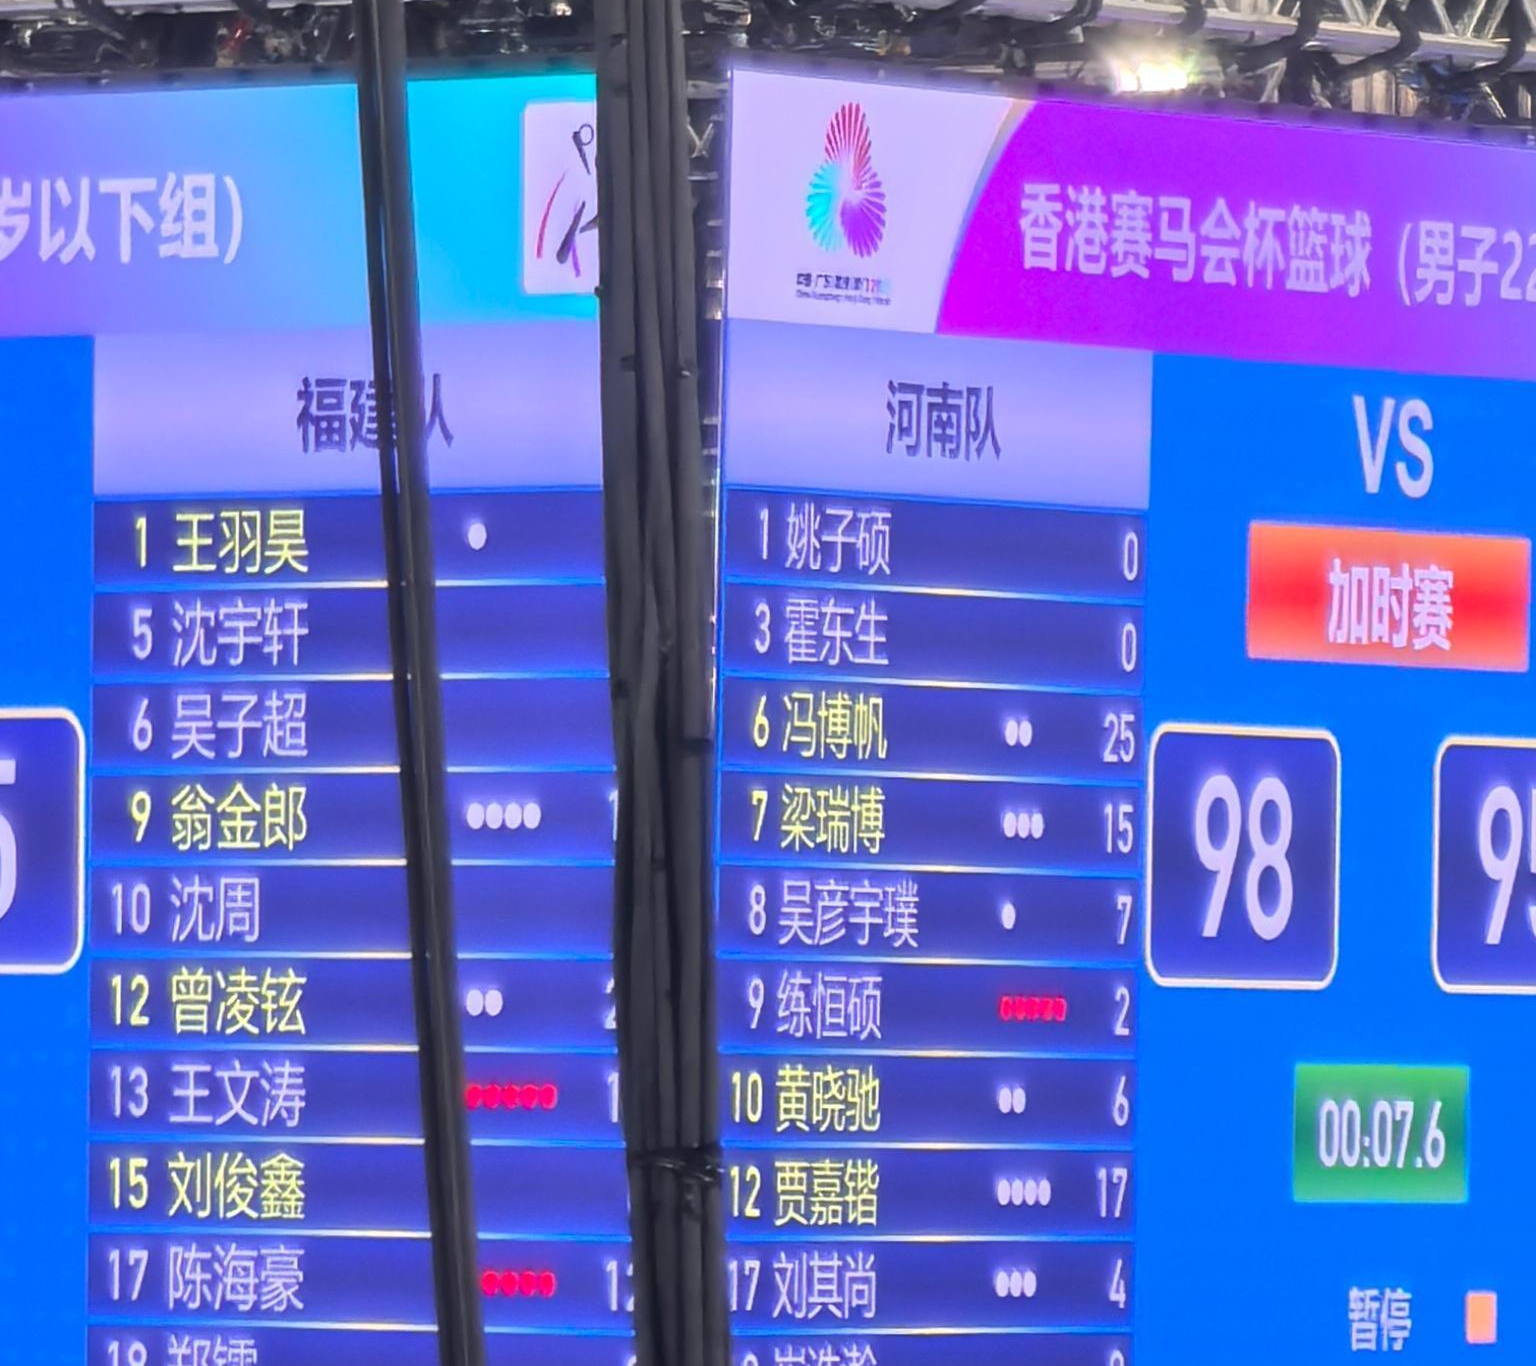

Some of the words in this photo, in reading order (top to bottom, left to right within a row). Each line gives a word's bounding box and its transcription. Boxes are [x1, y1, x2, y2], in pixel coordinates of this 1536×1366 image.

[887, 380, 1001, 461] 河南队
[1353, 395, 1433, 498] VS
[136, 517, 146, 567] 1
[173, 510, 308, 573] 王羽昊
[760, 508, 768, 559] 1
[786, 503, 891, 575] 姚子硕
[1123, 531, 1138, 580] 0
[133, 608, 152, 659] 5
[173, 598, 308, 666] 沈宇轩
[755, 603, 770, 653] 3
[785, 598, 888, 665] 霍东生
[1122, 623, 1136, 672] 0
[1328, 558, 1453, 650] 加时赛
[133, 698, 152, 750] 6
[172, 690, 307, 758] 吴子超
[753, 695, 769, 747] 6
[783, 691, 887, 759] 冯博帆
[1104, 712, 1134, 762] 25
[131, 791, 151, 842] 9
[172, 782, 307, 850] 翁金郎
[752, 790, 768, 841] 7
[781, 784, 885, 853] 梁瑞博
[1104, 803, 1133, 853] 15
[1194, 773, 1293, 940] 98
[112, 883, 150, 933] 10
[171, 875, 259, 942] 沈周
[749, 884, 766, 934] 8
[779, 879, 919, 947] 吴彦宇璞
[1117, 894, 1132, 944] 7
[112, 974, 149, 1025] 12
[172, 967, 306, 1034] 曾凌铉
[748, 977, 764, 1028] 9
[777, 971, 882, 1040] 练恒硕
[1114, 985, 1129, 1035] 2
[111, 1066, 148, 1117] 13
[170, 1060, 305, 1127] 王文涛
[732, 1071, 762, 1122] 10
[776, 1064, 880, 1131] 黄晓驰
[1112, 1076, 1129, 1126] 6
[1320, 1099, 1445, 1168] 00:07.6
[110, 1157, 148, 1208] 15
[168, 1152, 305, 1218] 刘俊鑫
[730, 1165, 760, 1217] 12
[775, 1159, 879, 1225] 贾嘉锴
[1098, 1167, 1127, 1217] 17
[109, 1249, 148, 1300] 17
[169, 1243, 304, 1311] 陈海豪
[728, 1260, 760, 1310] 17
[773, 1251, 875, 1318] 刘其尚
[1109, 1259, 1126, 1308] 4
[1349, 1287, 1411, 1351] 暂停
